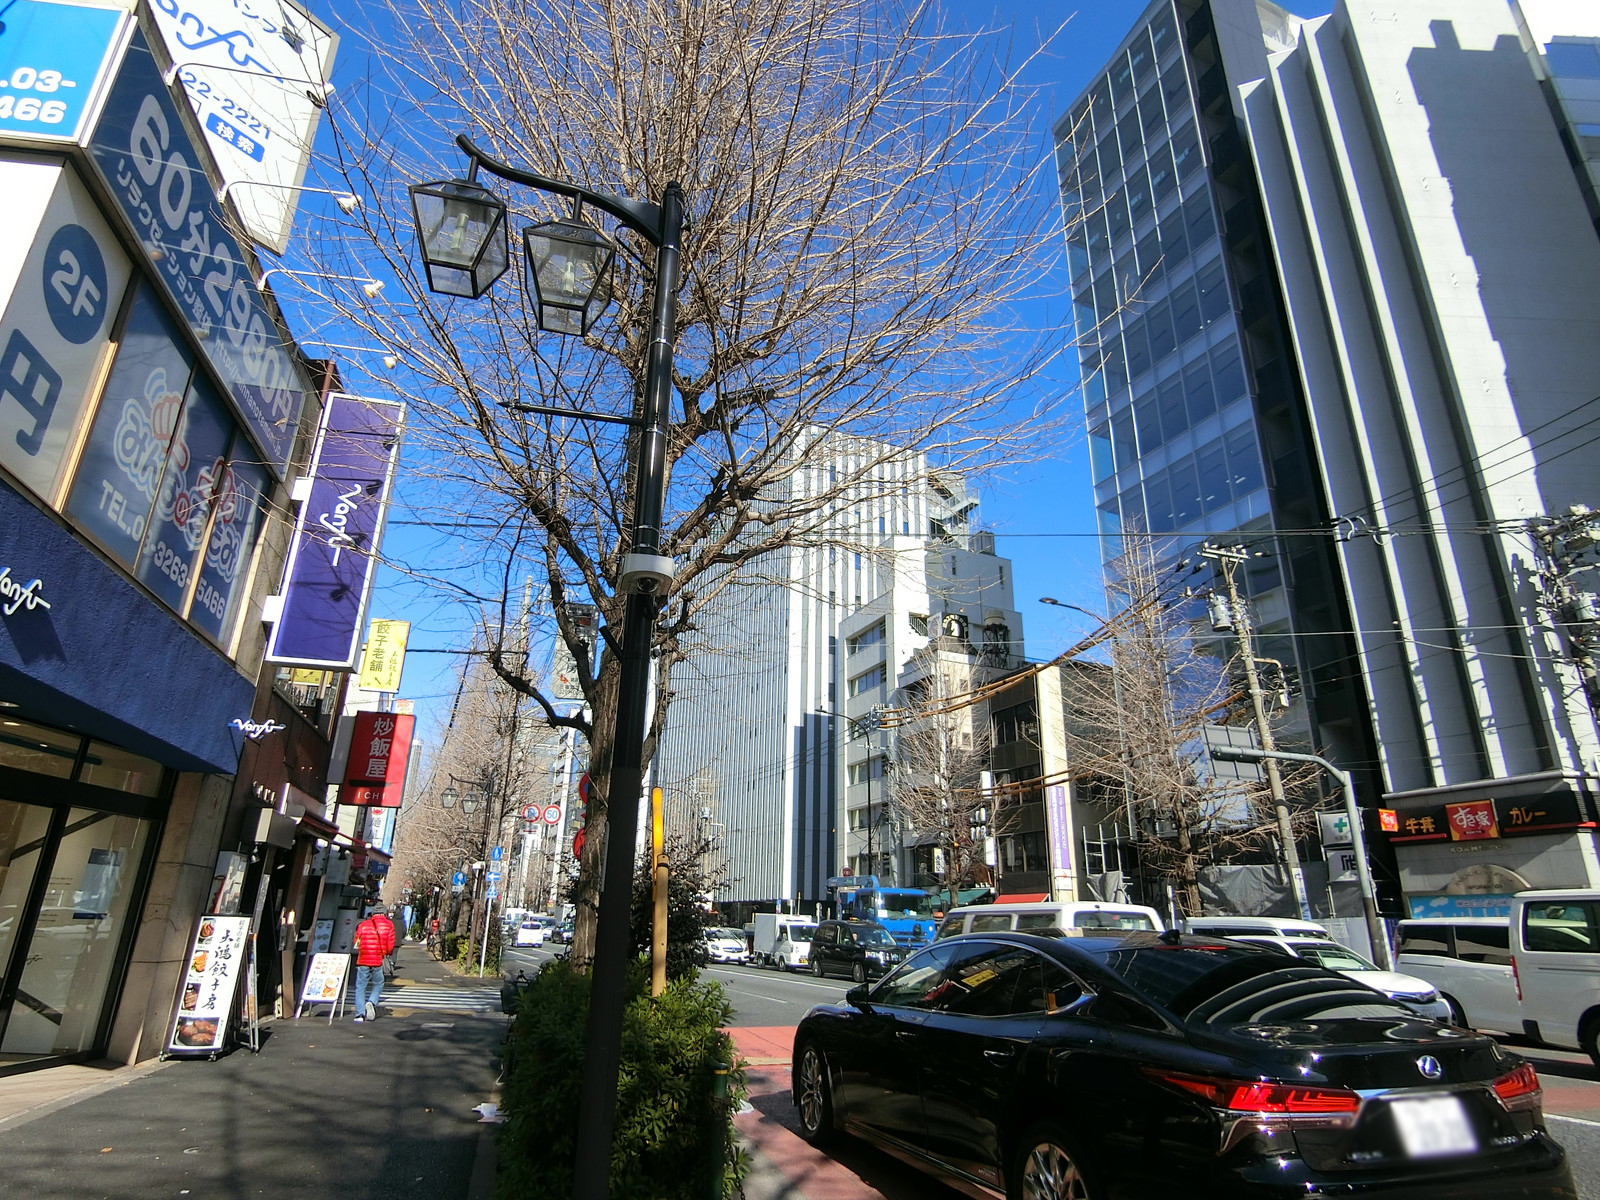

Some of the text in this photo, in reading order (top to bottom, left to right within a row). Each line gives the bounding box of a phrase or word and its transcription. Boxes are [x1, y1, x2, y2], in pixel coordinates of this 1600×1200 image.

[178, 66, 271, 139] 22-2221
[215, 121, 255, 155] 検索
[51, 249, 101, 317] 2F
[370, 621, 391, 672] 餃子老舗
[232, 718, 286, 738] Vanfu
[365, 717, 394, 778] 炒飯屋
[546, 809, 558, 819] 50
[1405, 816, 1436, 834] 牛丼
[1453, 806, 1491, 828] すき家
[1509, 807, 1546, 825] カレー
